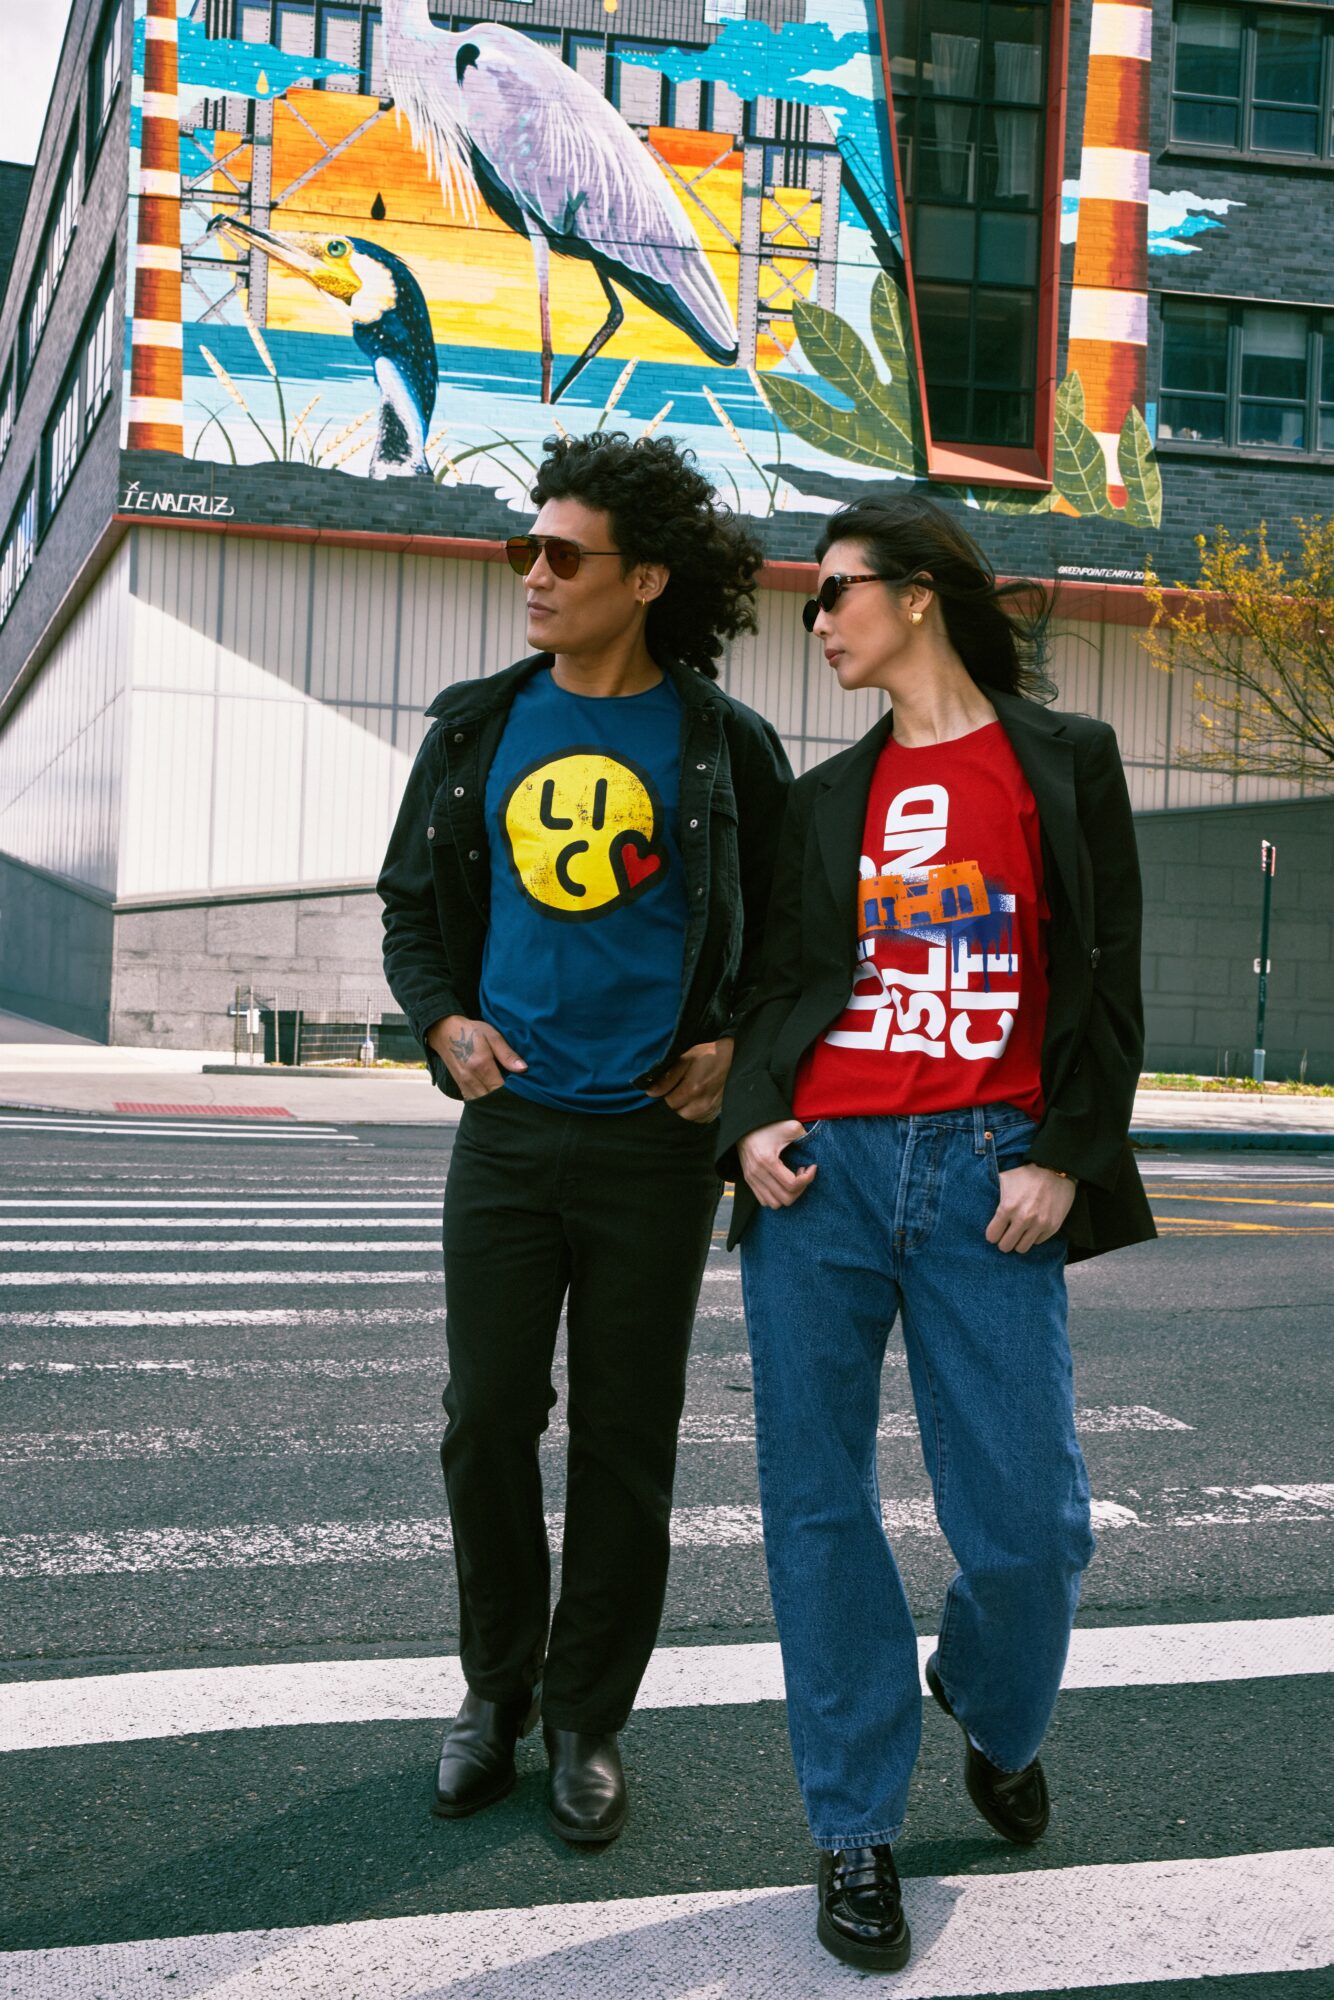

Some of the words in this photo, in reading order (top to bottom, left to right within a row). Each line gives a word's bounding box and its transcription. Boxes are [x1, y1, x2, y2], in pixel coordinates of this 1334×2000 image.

[824, 855, 894, 1050] LO
[881, 784, 949, 1058] ISLND
[950, 893, 1019, 1060] CIT
